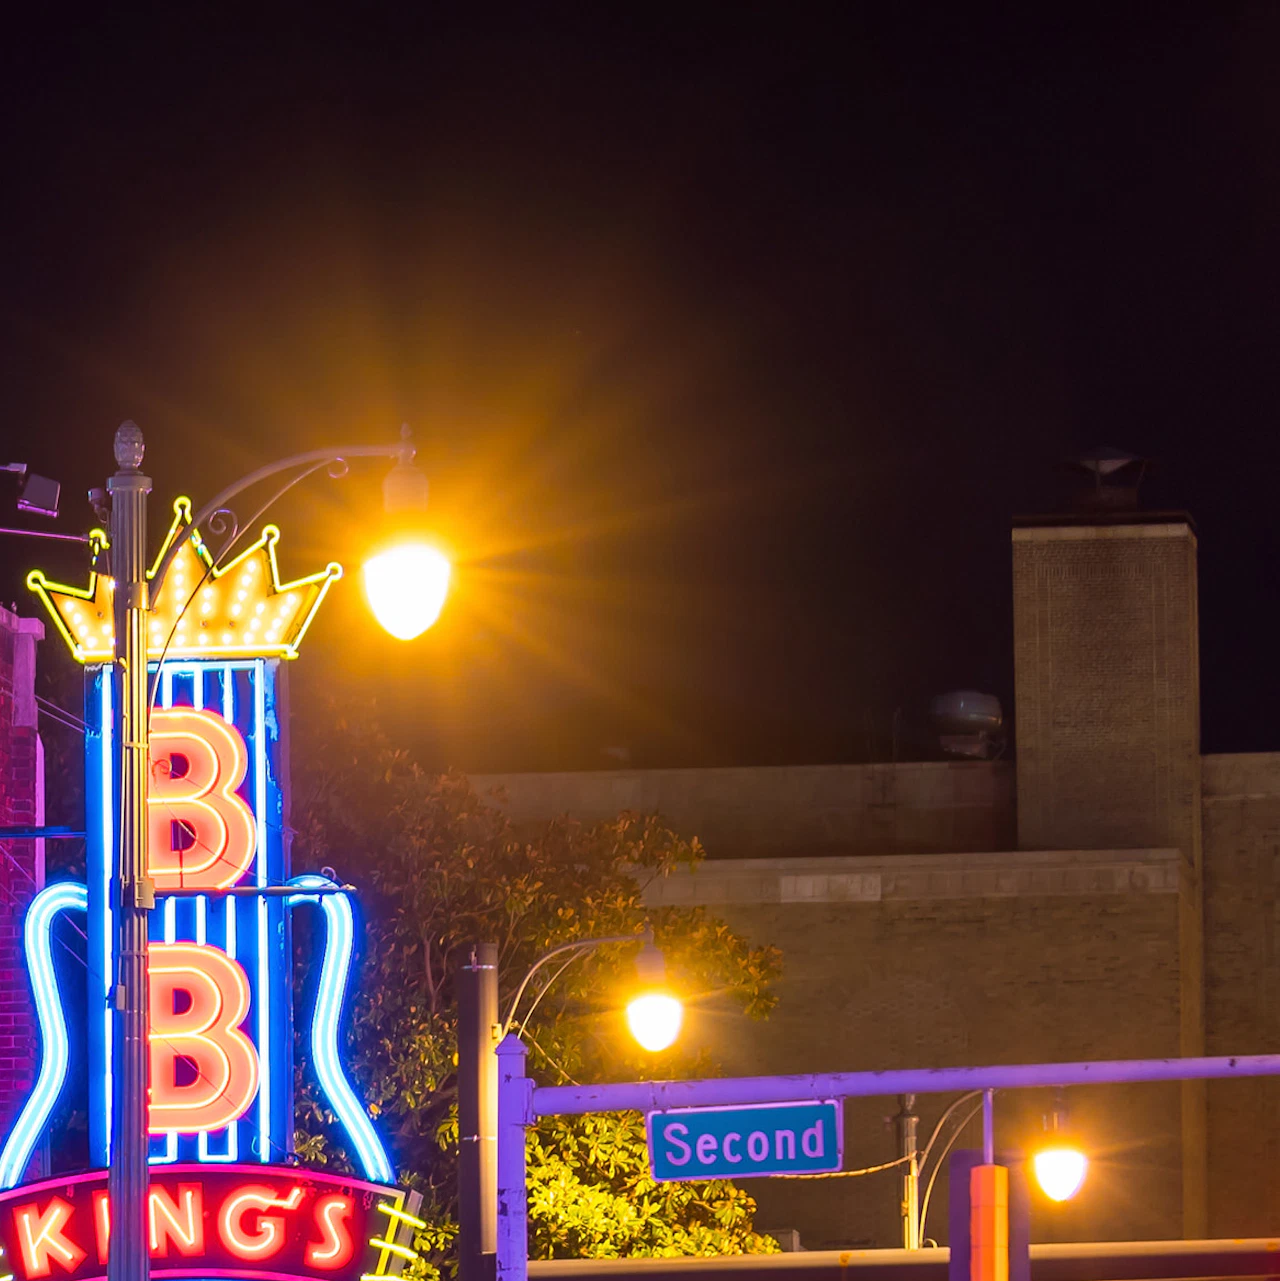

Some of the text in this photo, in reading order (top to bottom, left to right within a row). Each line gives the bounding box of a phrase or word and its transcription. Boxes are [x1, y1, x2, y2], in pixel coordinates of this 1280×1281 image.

[146, 704, 258, 893] B
[146, 941, 258, 1135] B
[662, 1119, 825, 1167] Second
